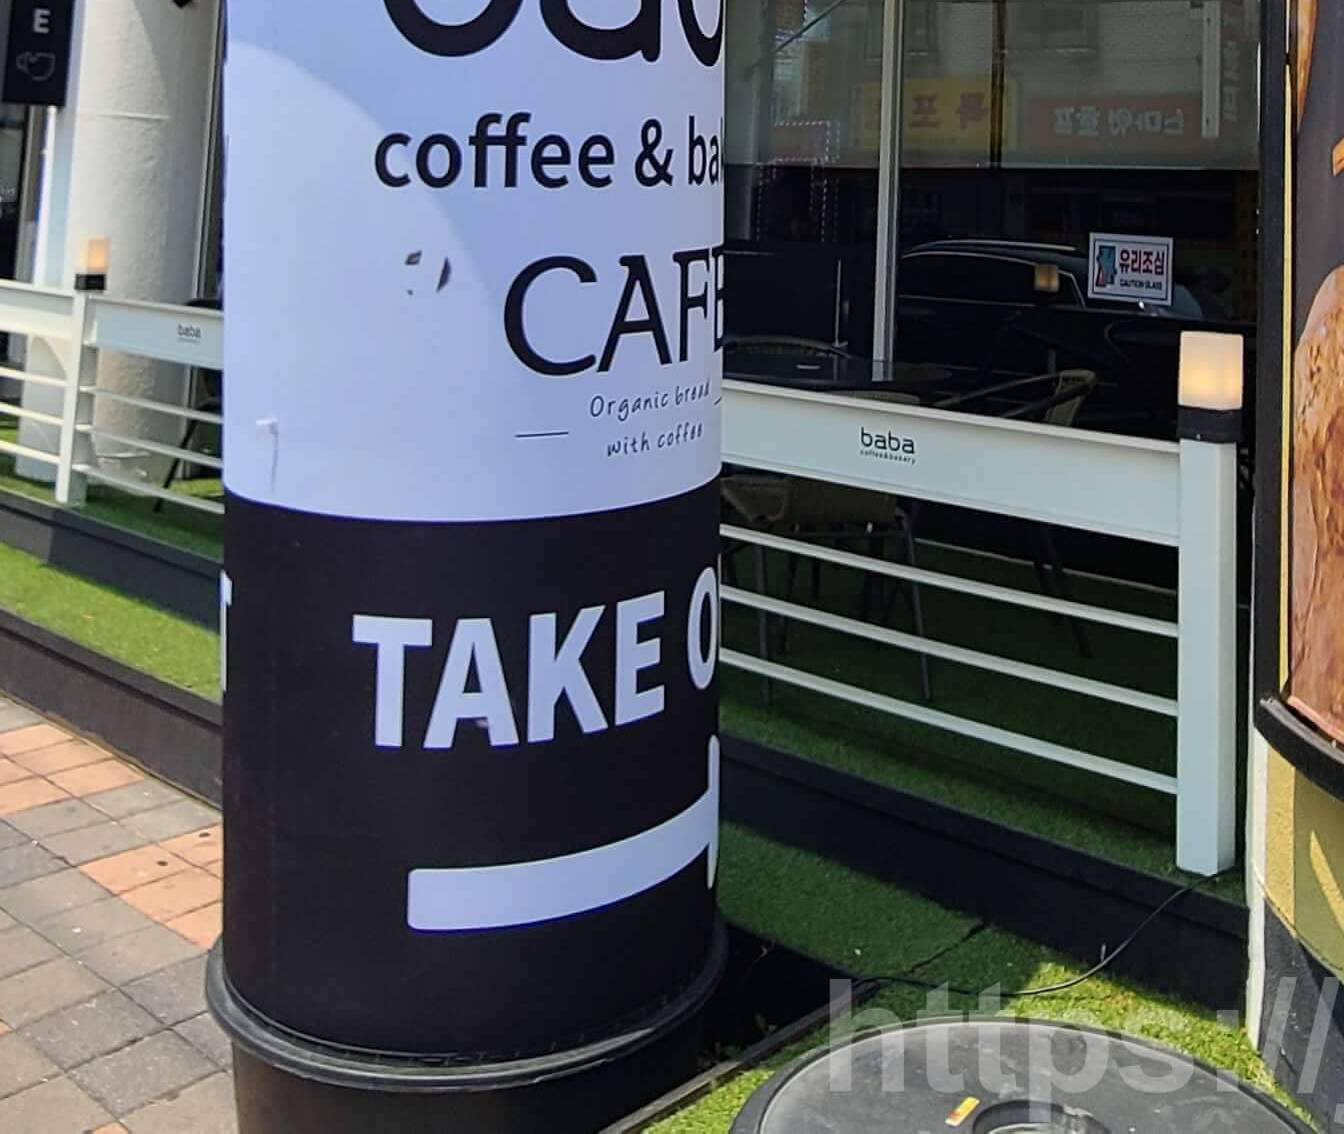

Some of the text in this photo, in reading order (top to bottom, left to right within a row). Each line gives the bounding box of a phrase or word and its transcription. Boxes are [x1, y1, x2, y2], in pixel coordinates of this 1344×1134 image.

[374, 112, 723, 188] coffee & ba
[1119, 249, 1165, 275] 유리조심
[590, 378, 710, 422] Organic bread
[607, 422, 703, 457] with coffee
[860, 426, 915, 454] baba
[352, 590, 665, 749] TAKE
